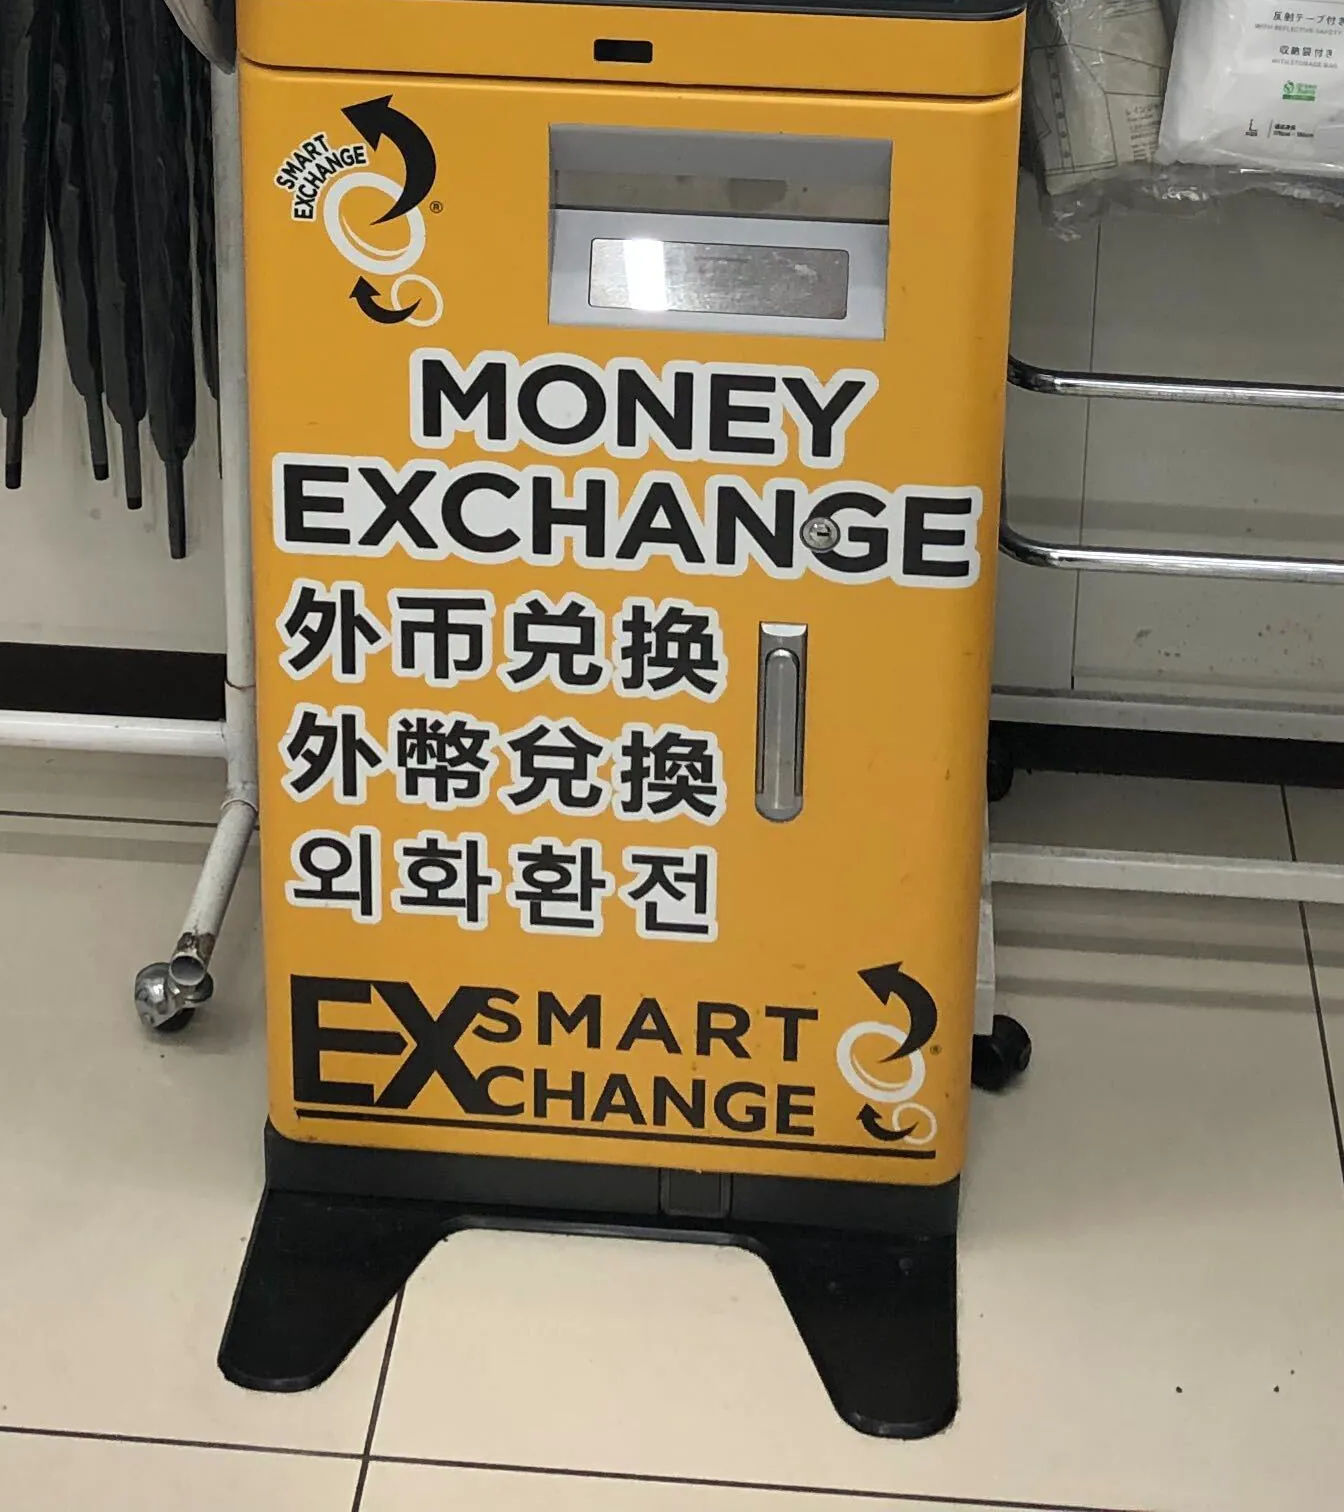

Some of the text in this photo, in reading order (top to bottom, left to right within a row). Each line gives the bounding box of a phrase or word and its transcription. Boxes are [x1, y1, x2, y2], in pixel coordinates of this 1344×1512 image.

[276, 133, 330, 191] SMART
[294, 143, 368, 220] EXCHANGE
[421, 358, 867, 458] MONEY
[282, 463, 973, 579] EXCHANGE
[285, 586, 720, 695] 外币兑换
[291, 832, 710, 936] 외화환전
[472, 986, 820, 1063] SMART
